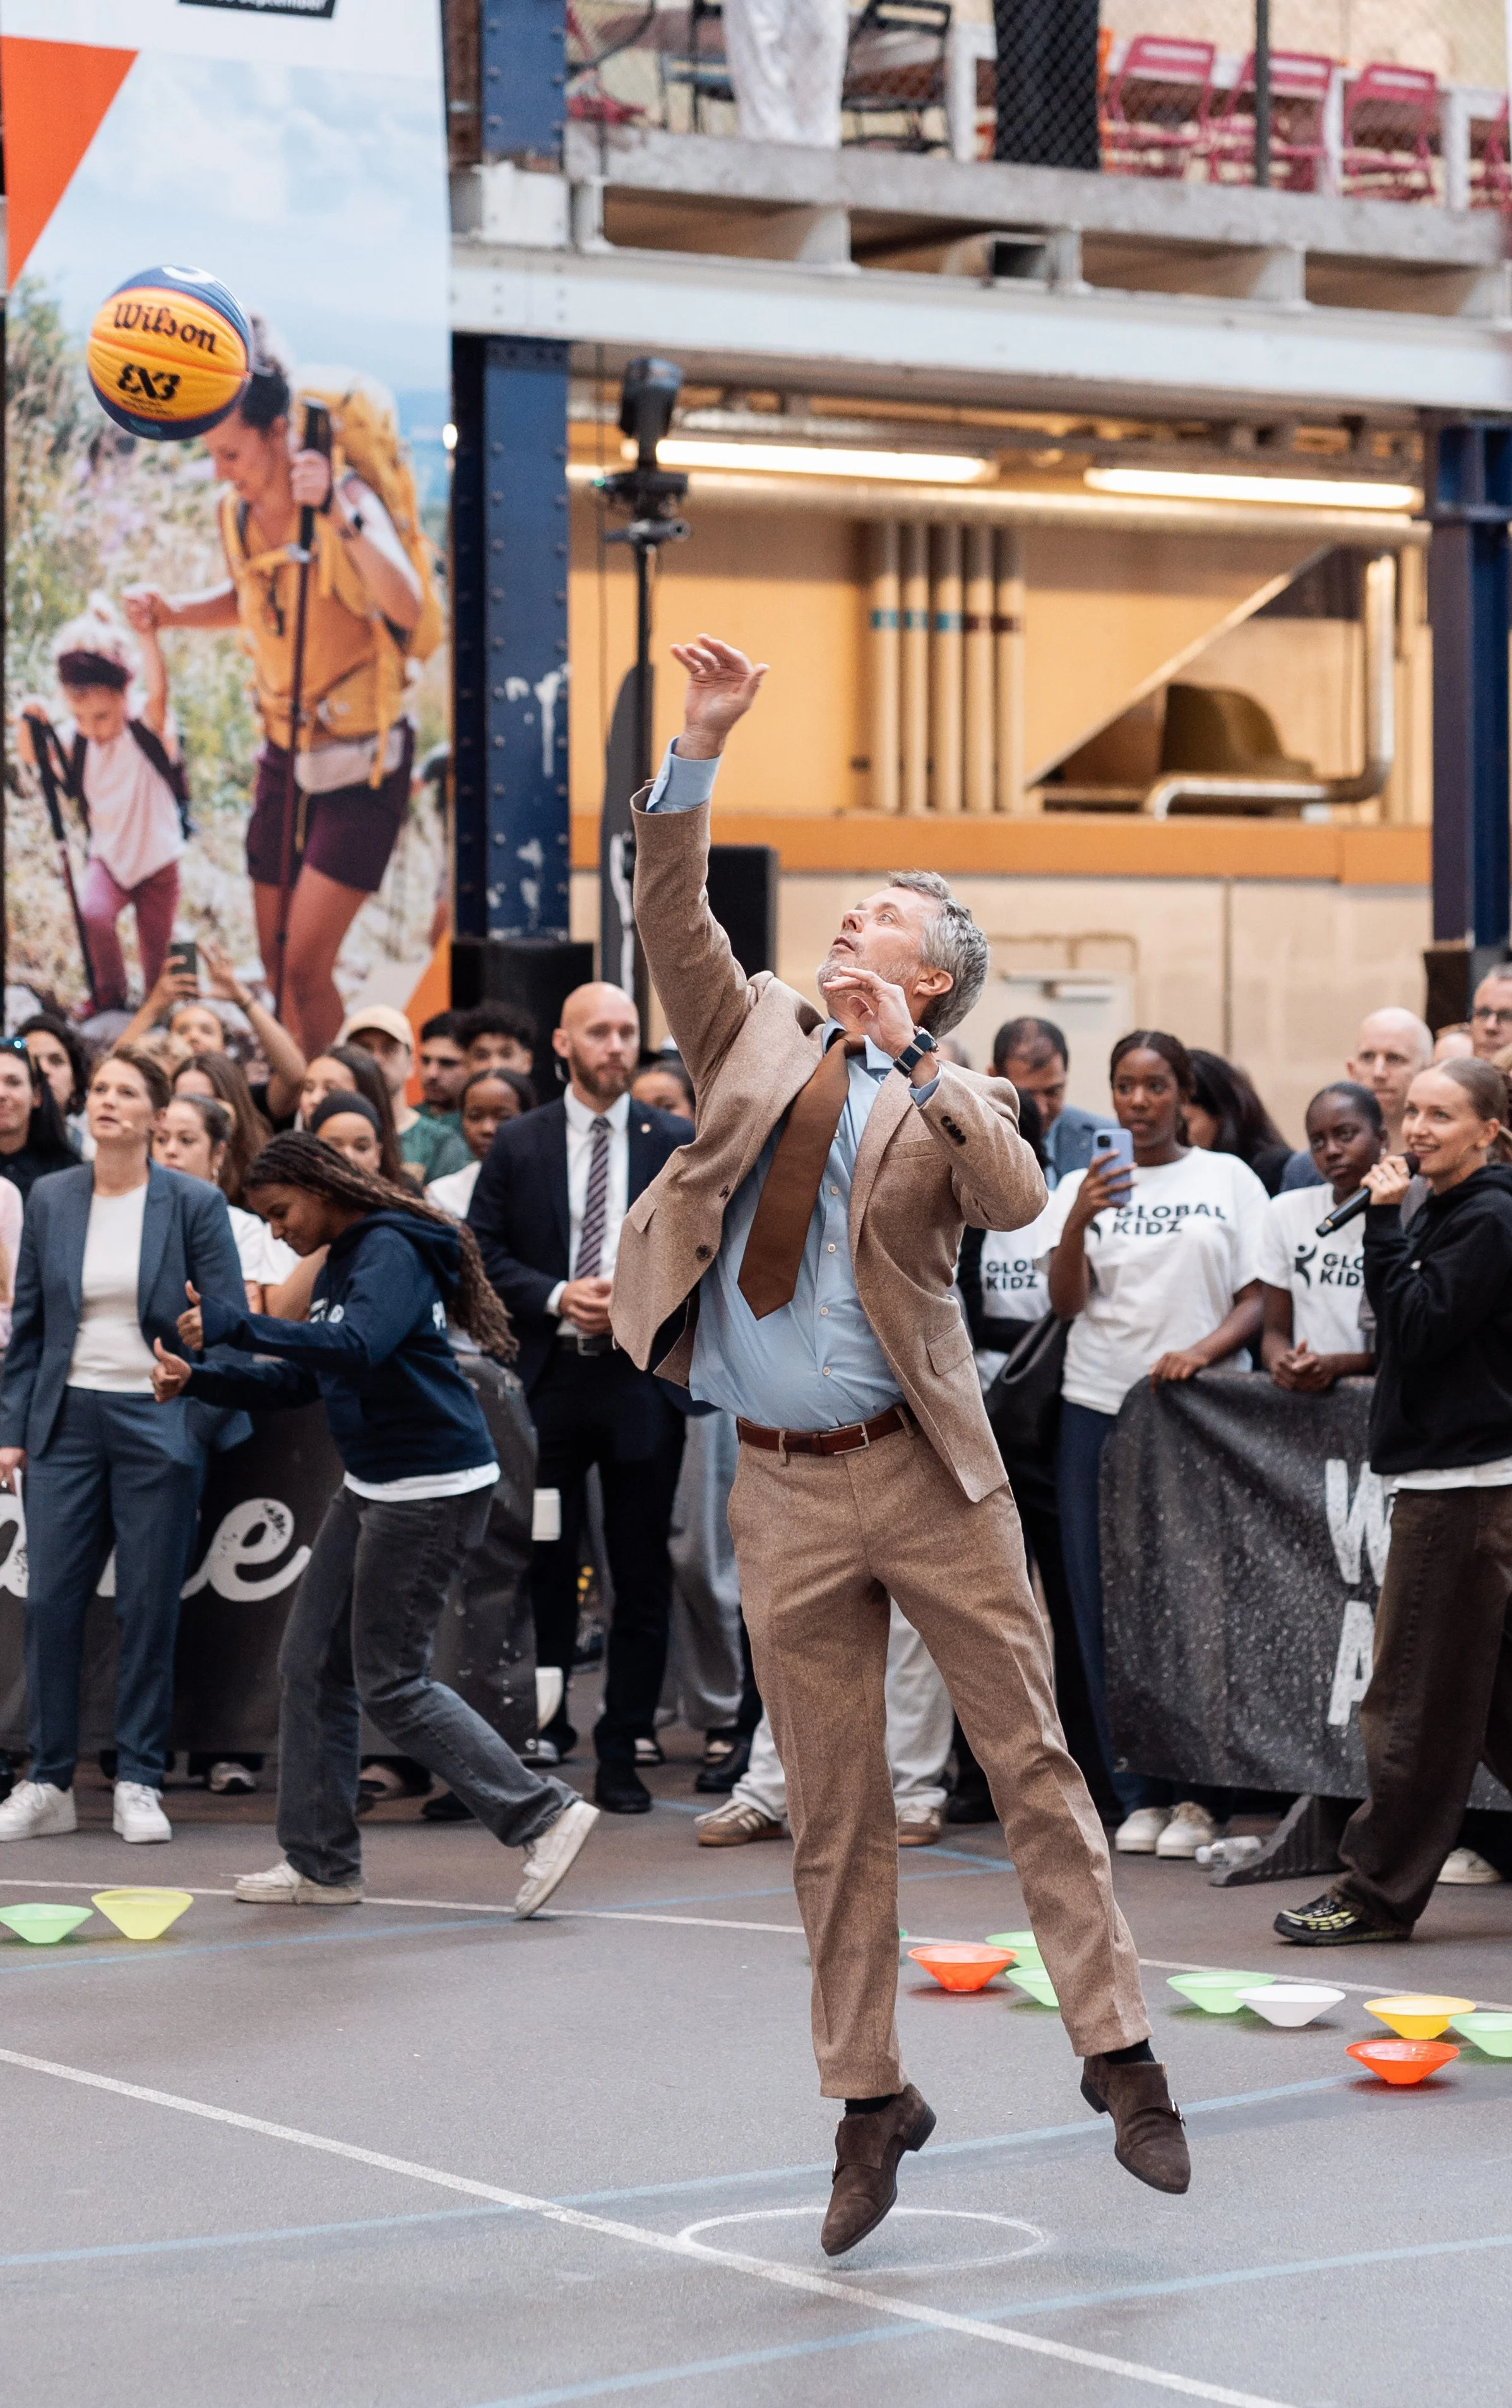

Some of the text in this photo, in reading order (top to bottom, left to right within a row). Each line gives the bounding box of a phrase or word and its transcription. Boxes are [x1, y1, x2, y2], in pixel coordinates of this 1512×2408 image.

[114, 302, 217, 354] Wilson
[1116, 1204, 1226, 1219] GLOBAL
[1113, 1221, 1182, 1235] KIDZ
[987, 1259, 1036, 1273] GLO
[987, 1275, 1037, 1290] KIDZ
